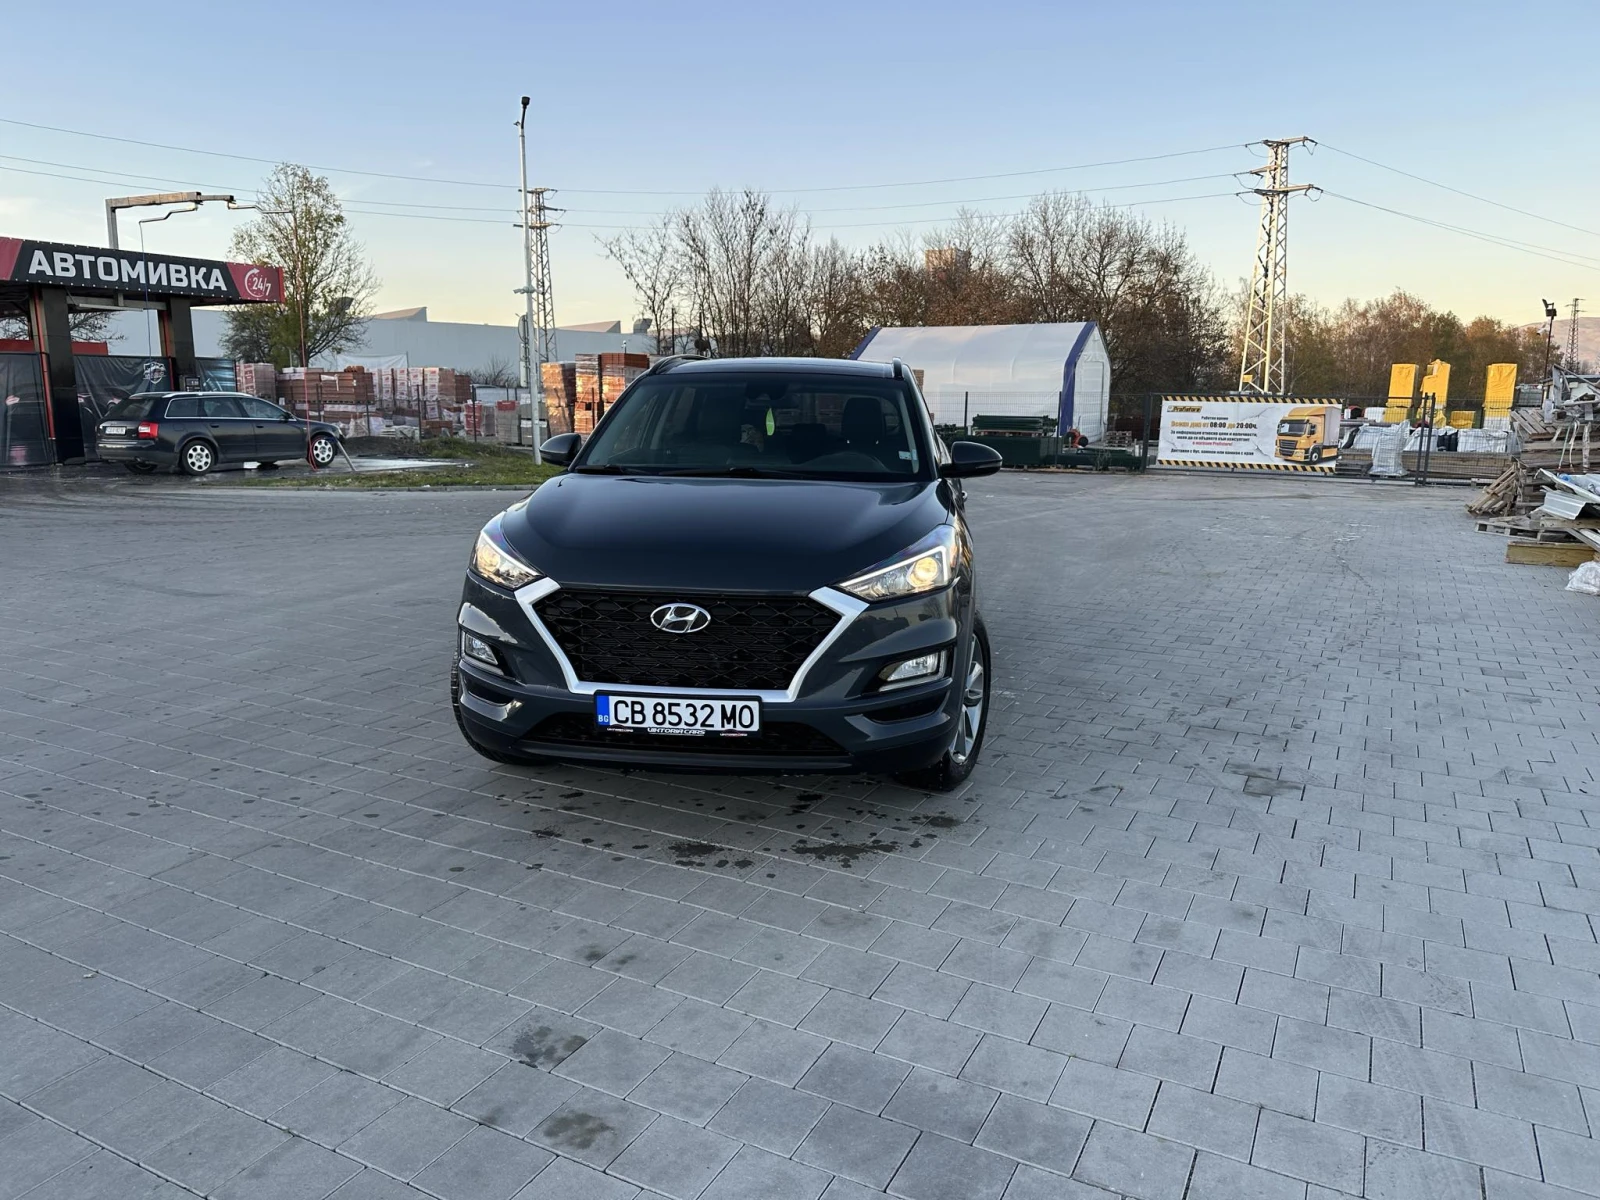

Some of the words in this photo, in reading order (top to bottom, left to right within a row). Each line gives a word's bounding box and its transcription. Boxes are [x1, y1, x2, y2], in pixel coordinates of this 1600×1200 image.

[28, 249, 228, 292] АВТОМИВКА
[252, 277, 271, 296] 24/7
[598, 714, 609, 723] BG
[614, 700, 646, 725] CB
[652, 702, 715, 728] 8532
[720, 704, 755, 729] MO
